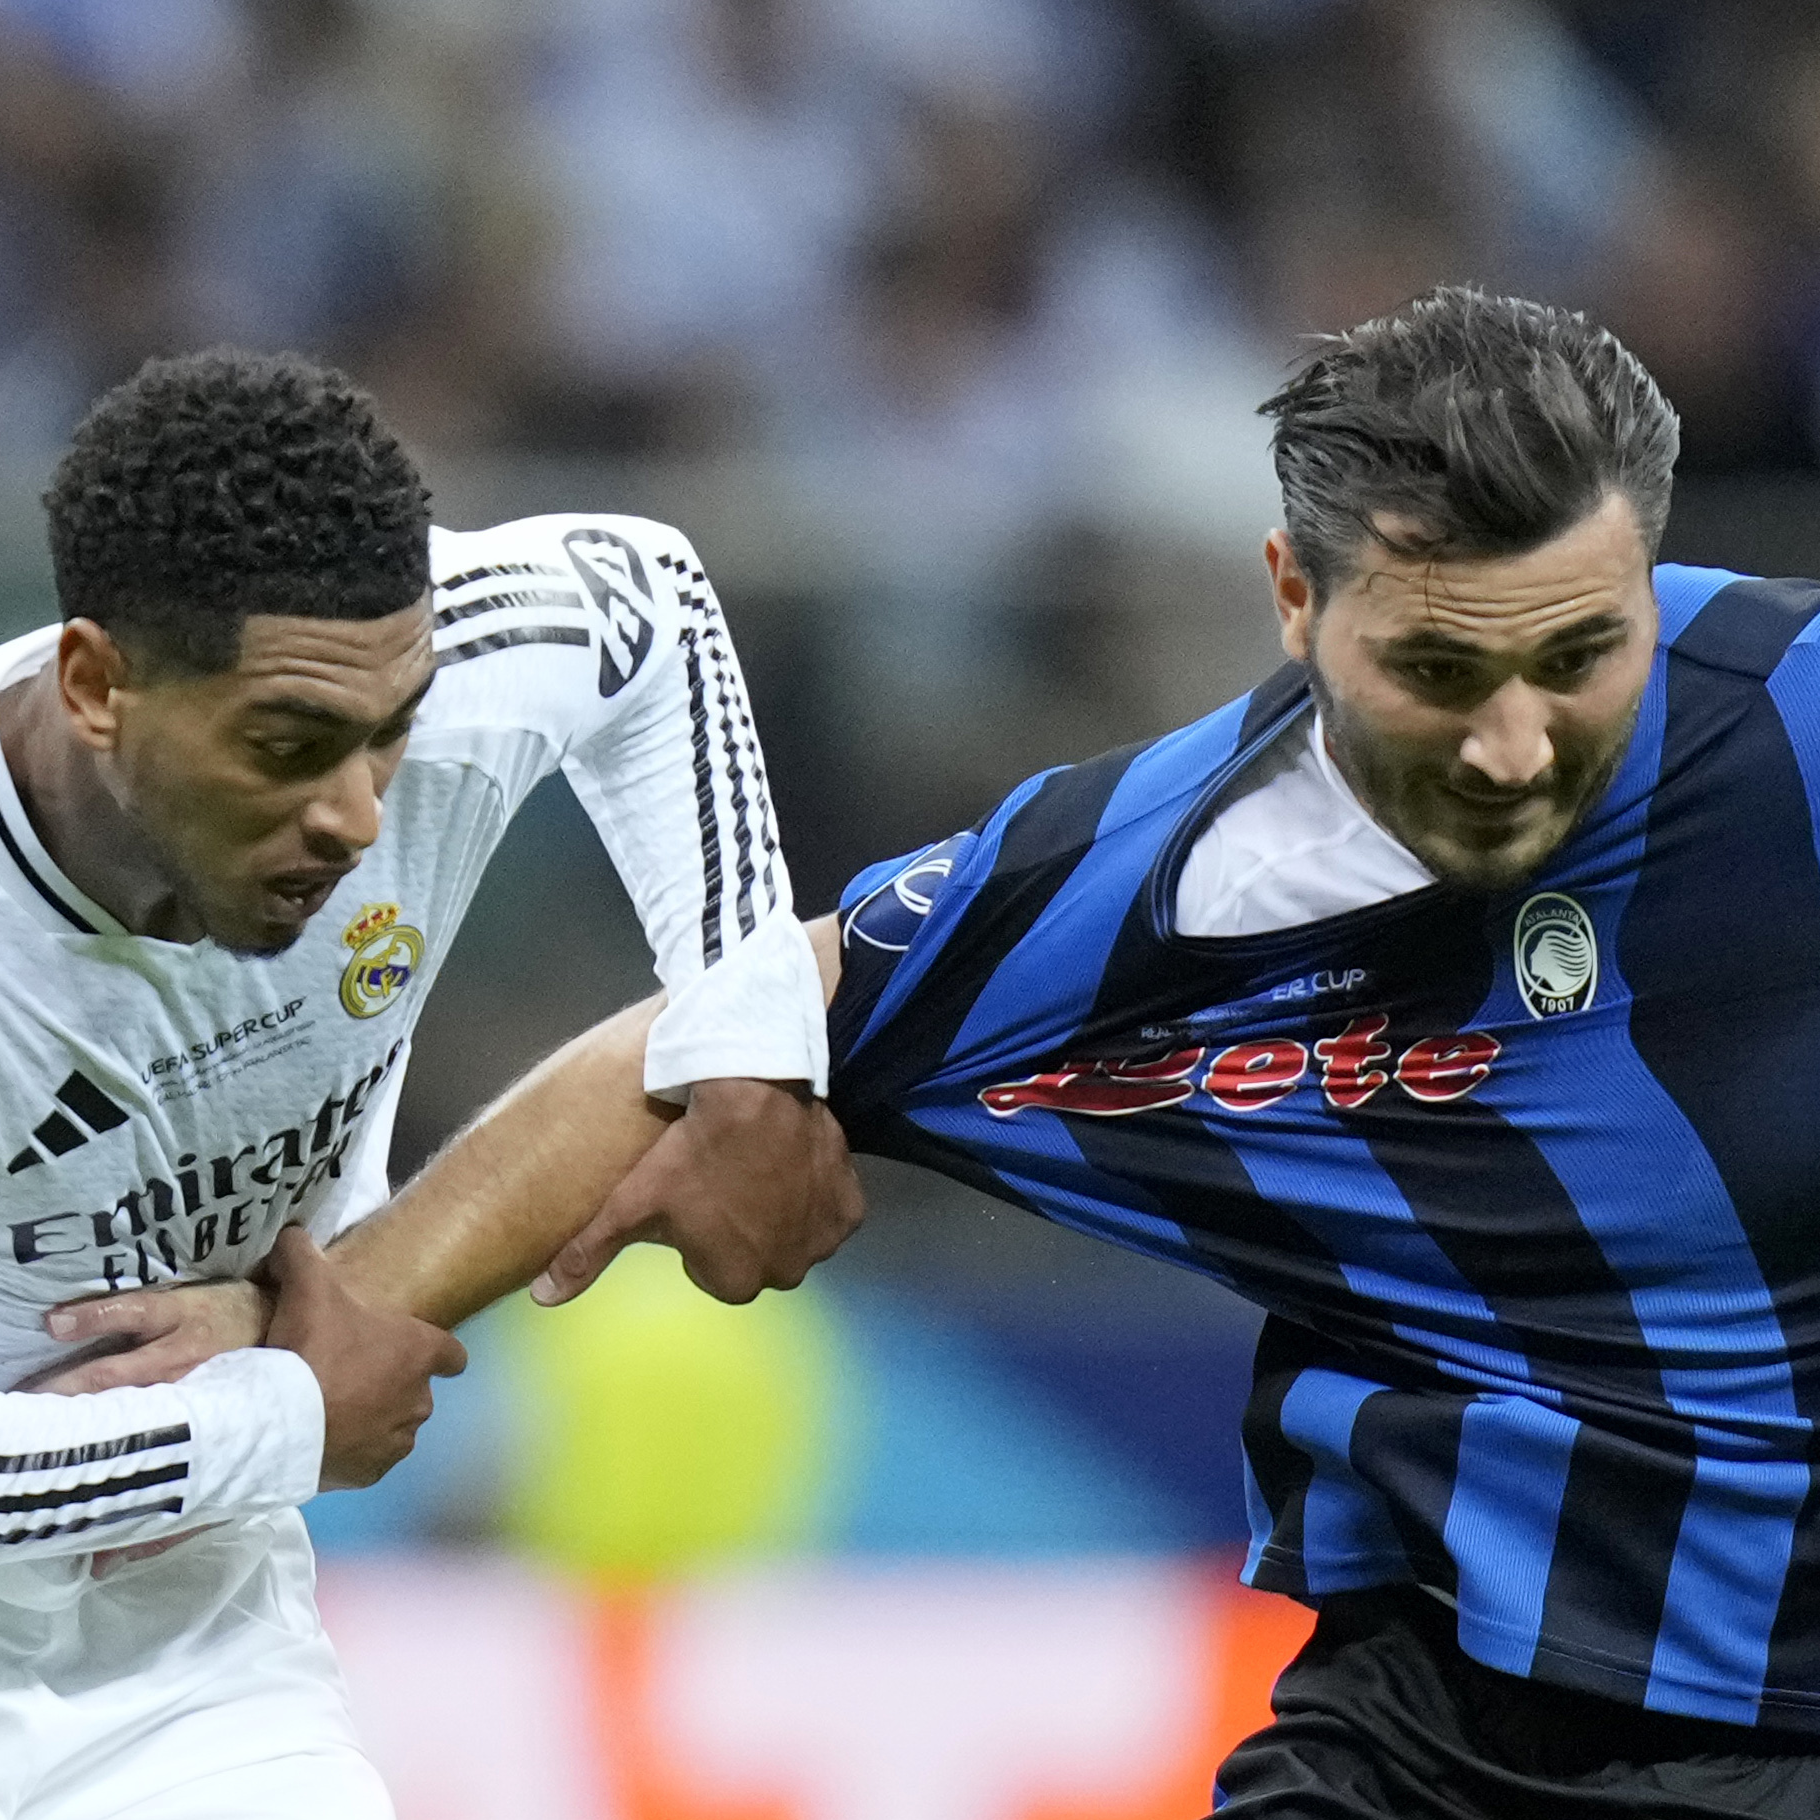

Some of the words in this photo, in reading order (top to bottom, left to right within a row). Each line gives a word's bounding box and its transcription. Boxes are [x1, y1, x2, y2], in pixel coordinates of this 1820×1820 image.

[1312, 968, 1366, 994] CUP
[1540, 996, 1575, 1013] 1907
[141, 1054, 189, 1085] UEFA
[191, 1018, 260, 1061] SUPER
[261, 995, 307, 1029] CUP
[7, 1037, 403, 1264] Emirates
